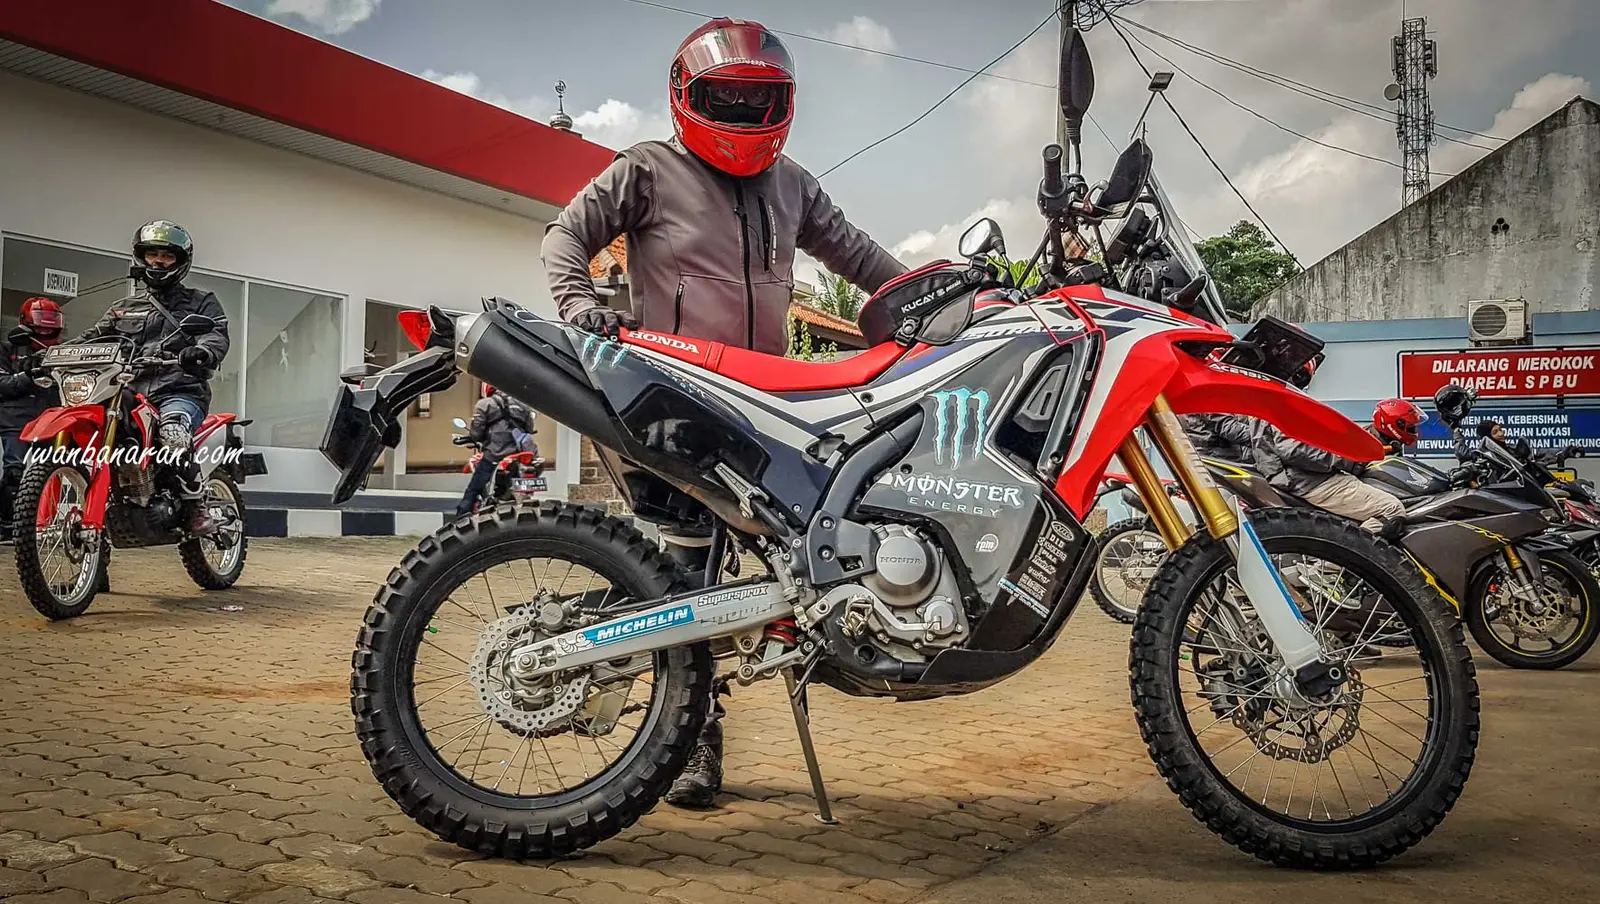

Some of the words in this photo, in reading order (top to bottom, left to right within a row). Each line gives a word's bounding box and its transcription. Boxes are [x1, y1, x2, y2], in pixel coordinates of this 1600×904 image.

[901, 292, 935, 314] KUCAY
[627, 330, 700, 354] HONDA
[1432, 358, 1509, 374] DILARANG
[1517, 355, 1595, 371] MEROKOK
[1507, 414, 1568, 424] KEBERSIHAN
[1535, 427, 1571, 437] LOKASI
[894, 474, 1021, 506] MONSTER
[909, 497, 1001, 516] ENERGY
[880, 556, 923, 565] HONDA
[697, 584, 769, 607] Supersprox
[597, 608, 689, 640] MICHELIN
